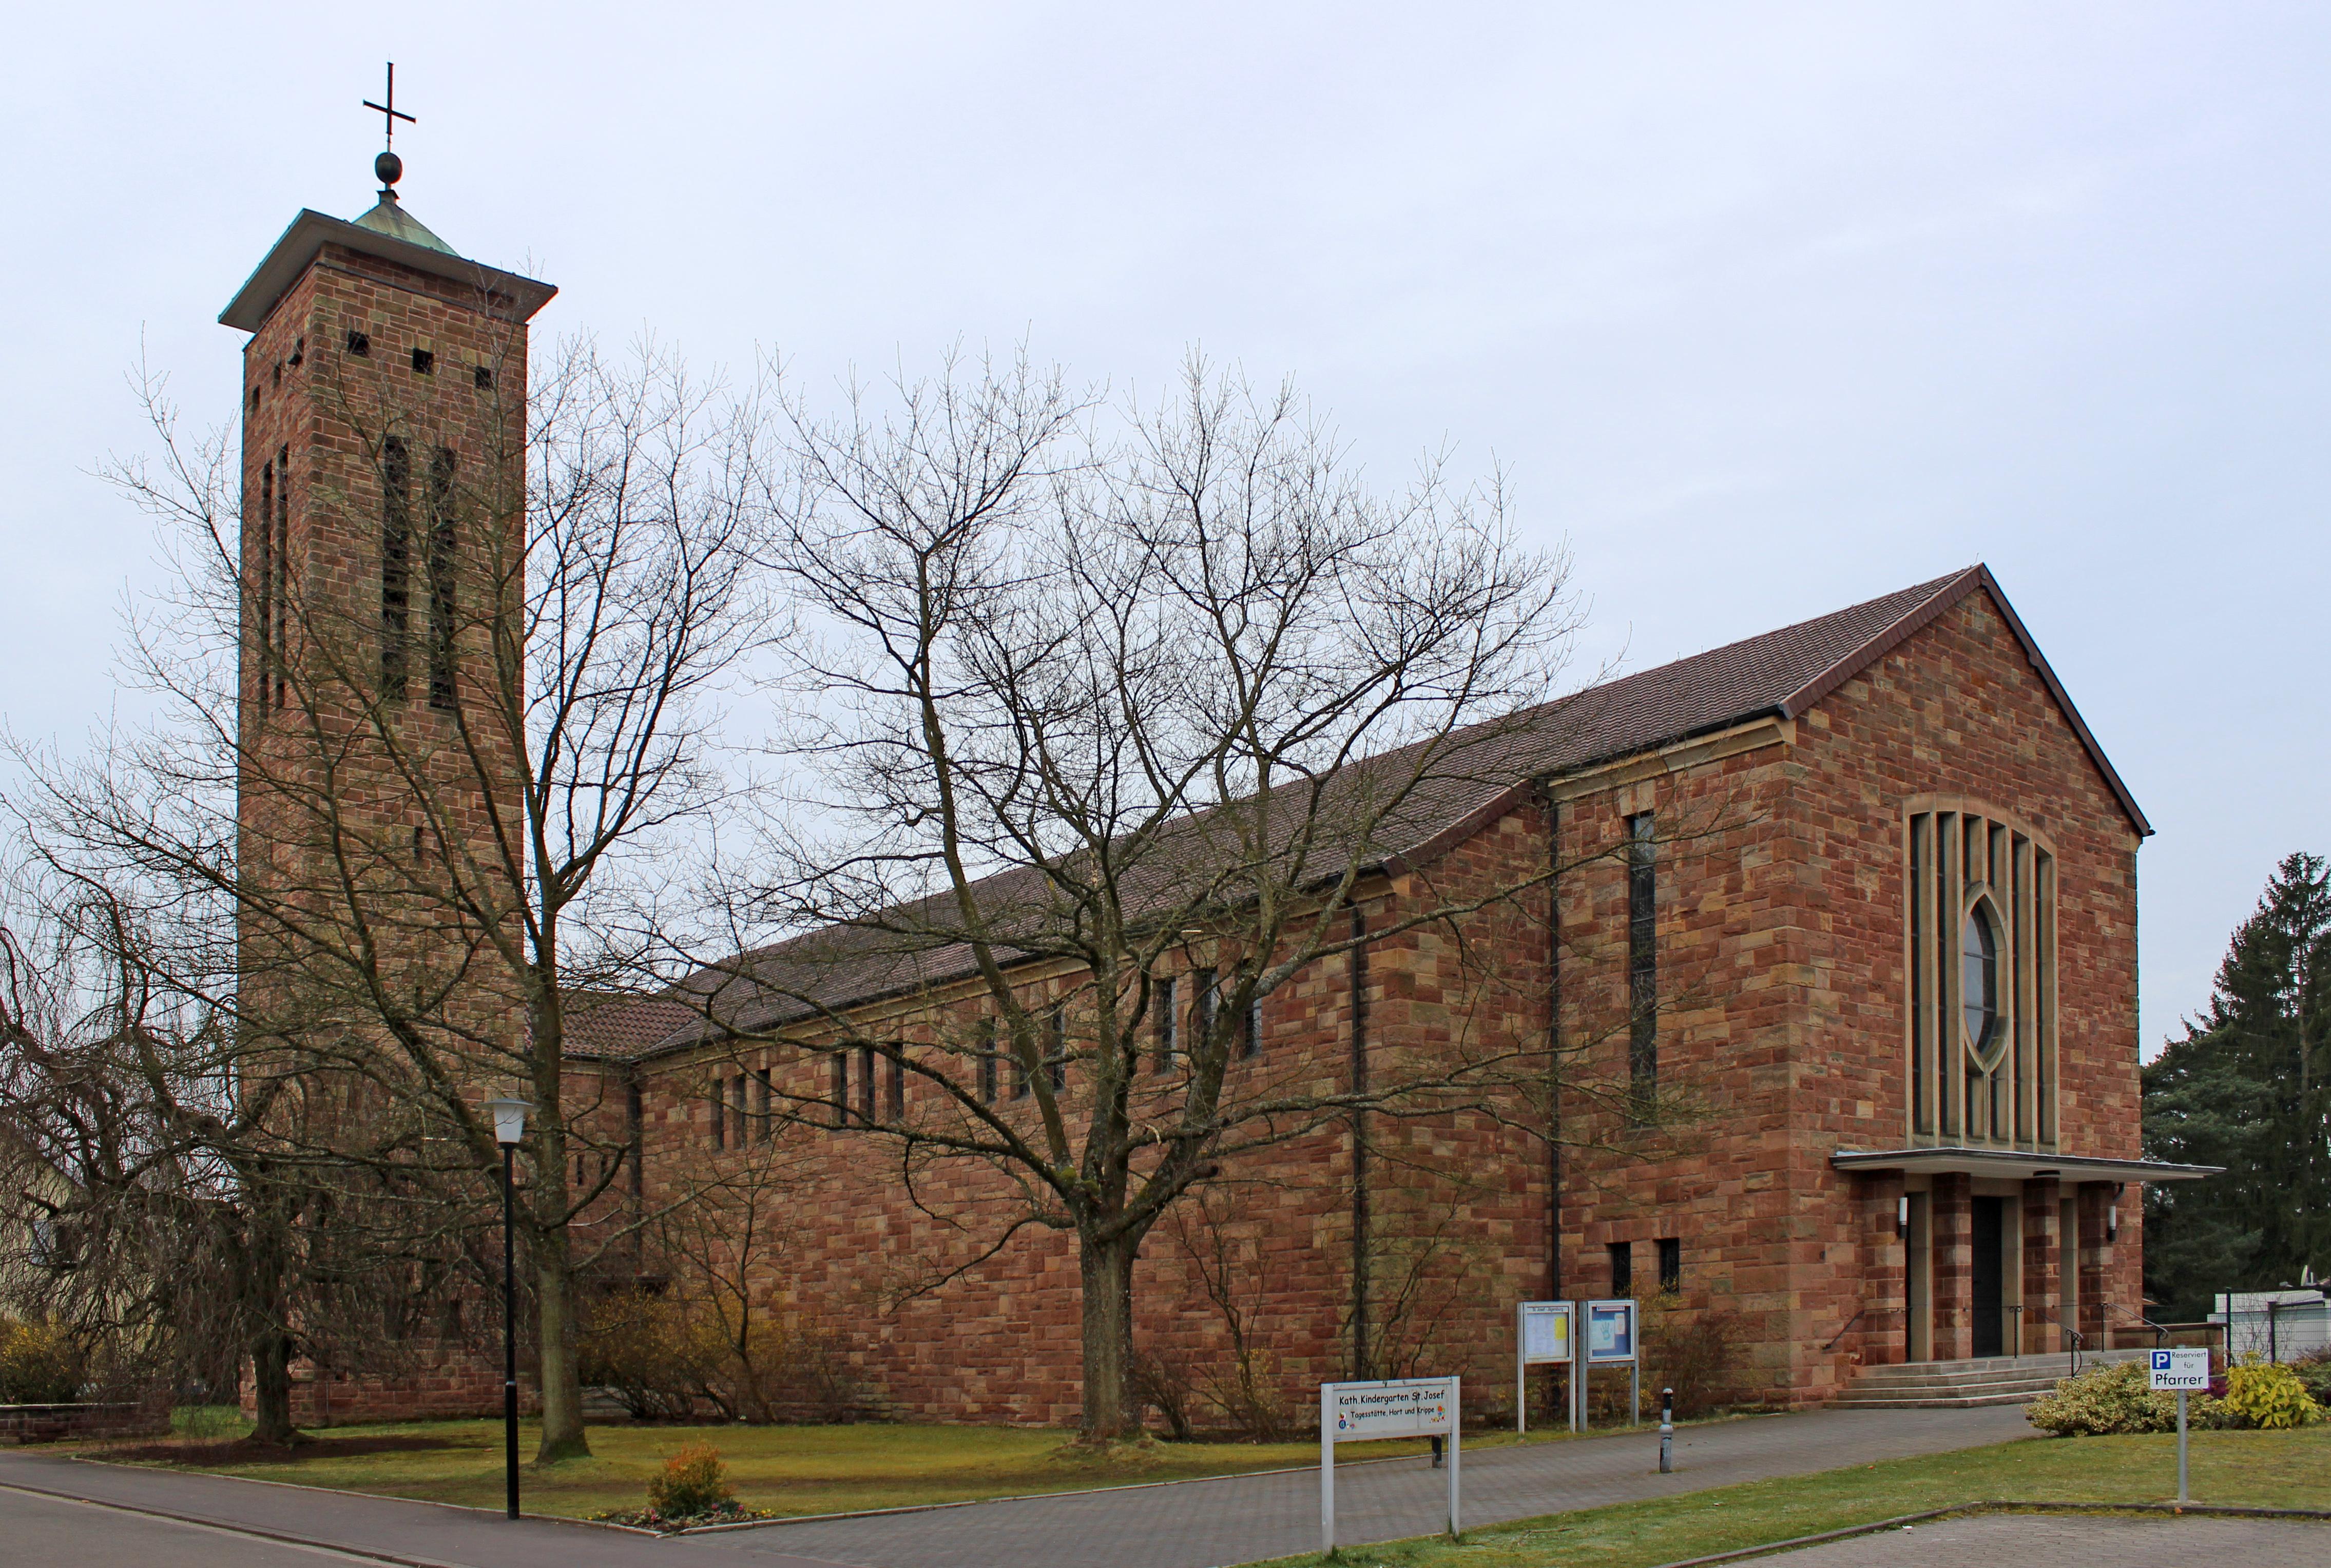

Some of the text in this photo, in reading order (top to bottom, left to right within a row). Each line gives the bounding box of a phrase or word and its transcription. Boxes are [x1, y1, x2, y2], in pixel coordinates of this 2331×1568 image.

[2156, 1353, 2168, 1368] P
[2156, 1373, 2203, 1385] Pfarrer
[1417, 1407, 1434, 1415] Krippe
